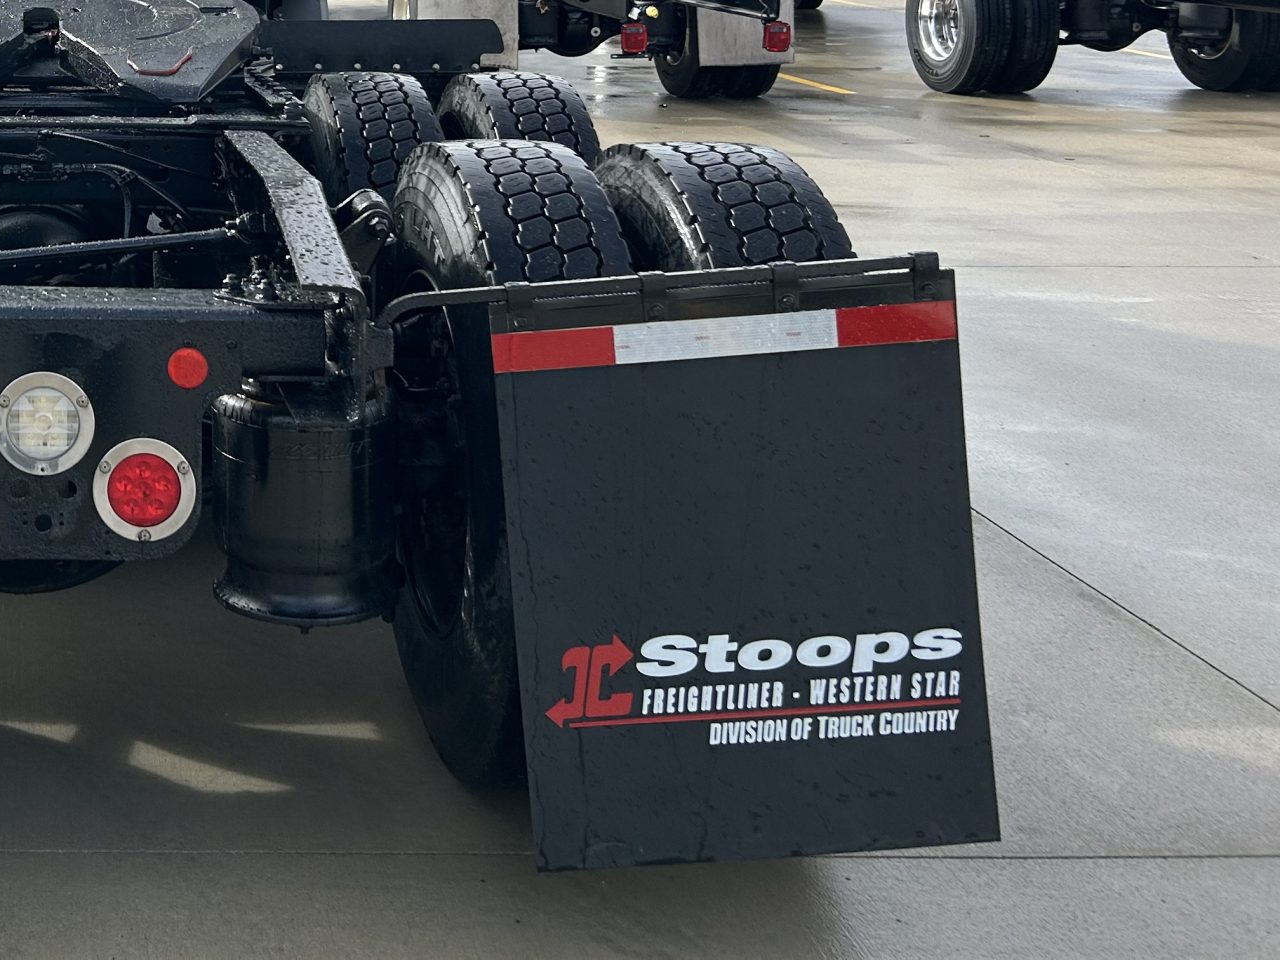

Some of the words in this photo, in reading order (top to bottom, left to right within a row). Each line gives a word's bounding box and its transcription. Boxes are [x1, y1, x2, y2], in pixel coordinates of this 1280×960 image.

[635, 627, 963, 678] Stoops
[641, 681, 784, 715] FREIGHTLINER
[809, 674, 902, 705] WESTERN
[910, 670, 961, 699] STAR
[709, 718, 788, 746] DIVISION
[790, 717, 813, 741] OF
[816, 714, 875, 740] TRUCK
[878, 708, 960, 735] COUNTRY
